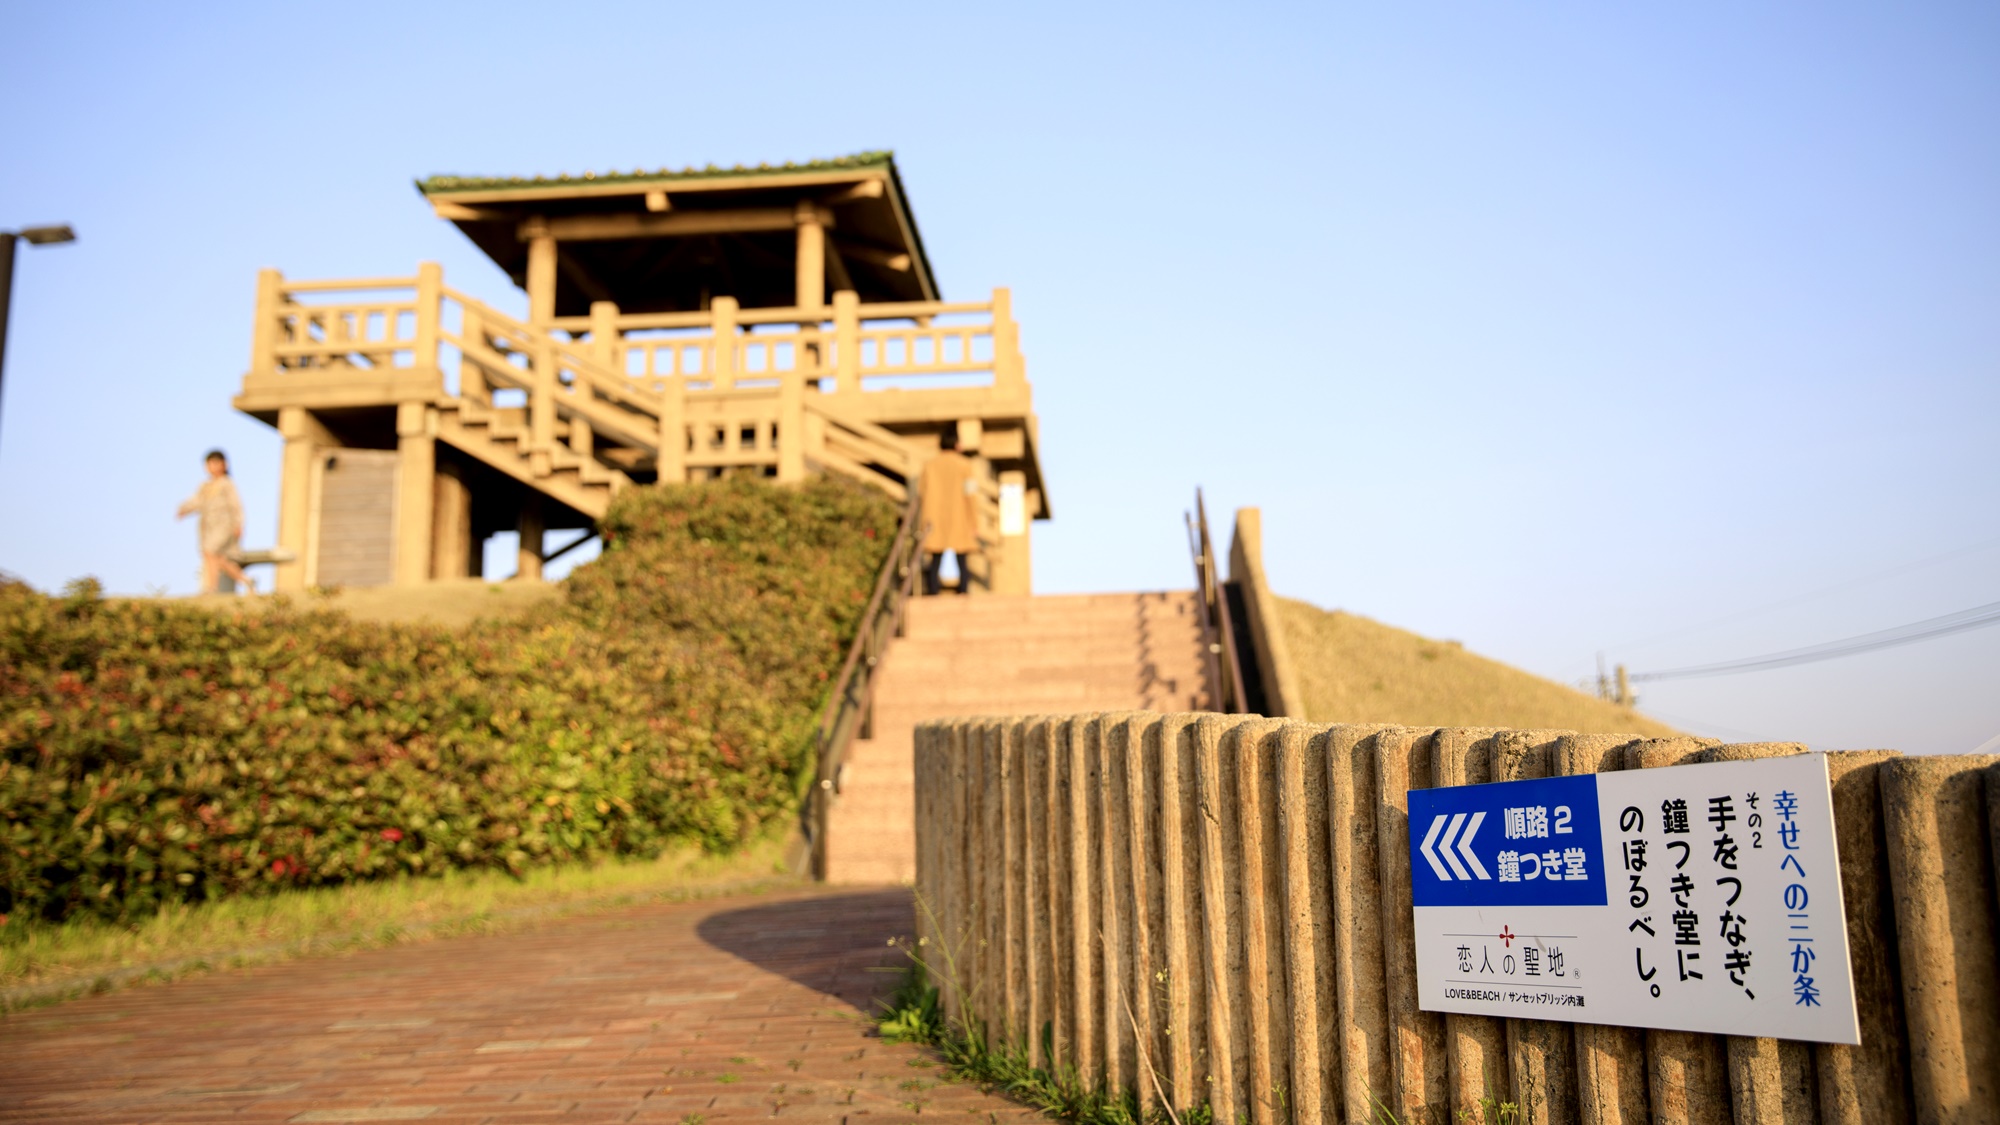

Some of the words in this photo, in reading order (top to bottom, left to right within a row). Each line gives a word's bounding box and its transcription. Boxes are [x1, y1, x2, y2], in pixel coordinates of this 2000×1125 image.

[1497, 847, 1588, 882] 鐘つき堂
[1745, 791, 1762, 849] その2
[1619, 805, 1661, 998] のぼるべし。
[1661, 798, 1703, 982] 鐘つき堂に
[1707, 795, 1755, 1001] 手をつなぎ、
[1773, 790, 1821, 1007] 幸せへの三か条
[1444, 988, 1500, 1002] LOVE&BEACH
[1508, 992, 1585, 1008] サンセットブリッジ内灘
[1457, 944, 1565, 977] 恋人の聖地
